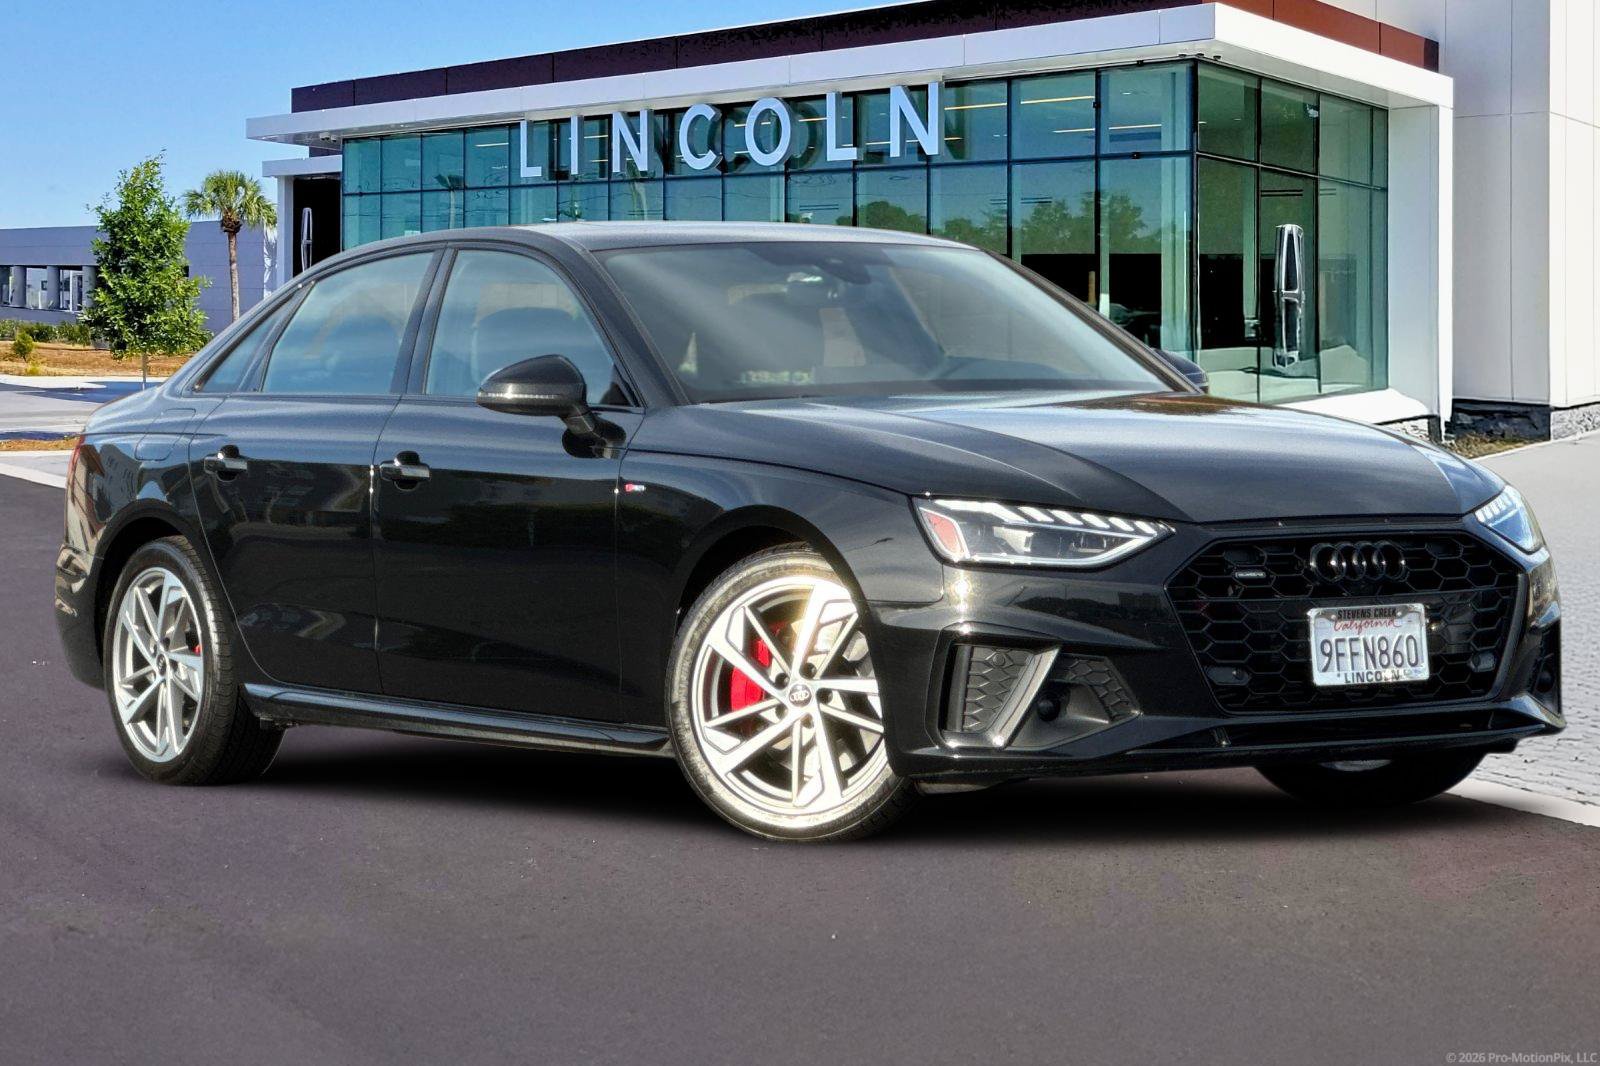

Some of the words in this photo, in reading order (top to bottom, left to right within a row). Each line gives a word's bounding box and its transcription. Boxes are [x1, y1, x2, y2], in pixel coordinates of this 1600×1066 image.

[520, 81, 942, 178] LINCOLN
[1337, 608, 1371, 620] STEVENS
[1373, 607, 1397, 618] CREEK
[1334, 618, 1402, 635] California
[1320, 634, 1419, 673] 9FFN860
[1344, 669, 1400, 684] LINCON
